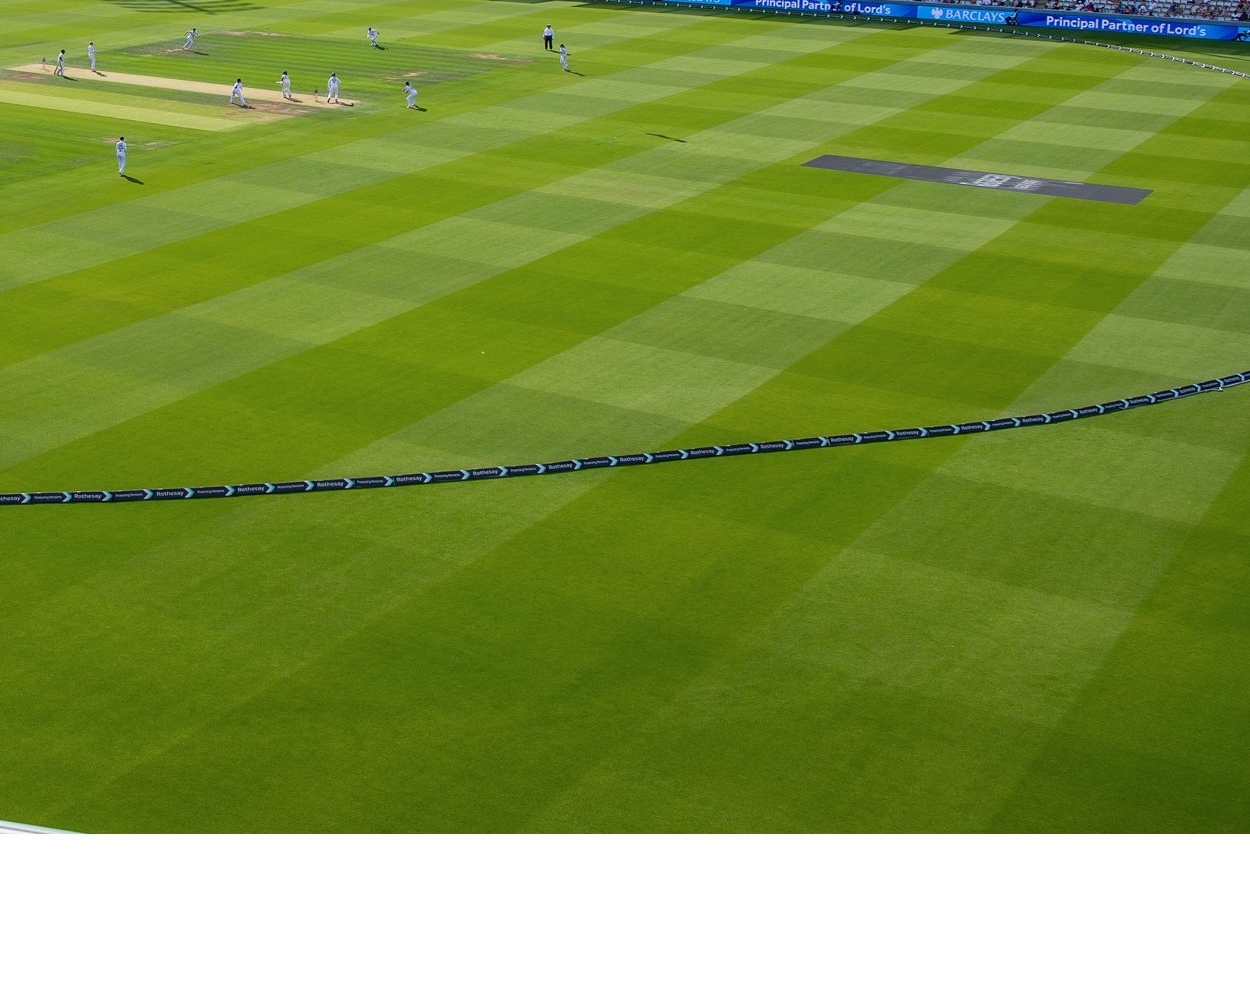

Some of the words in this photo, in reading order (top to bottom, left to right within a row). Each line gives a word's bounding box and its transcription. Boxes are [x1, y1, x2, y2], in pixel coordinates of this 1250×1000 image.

[802, 0, 839, 10] Partn
[844, 3, 854, 12] of
[857, 3, 891, 14] Lord's
[946, 10, 1005, 22] BARCLAYS
[1046, 16, 1098, 29] Principal
[1102, 19, 1148, 31] Partner
[1151, 23, 1165, 33] of
[1166, 24, 1206, 36] Lord's
